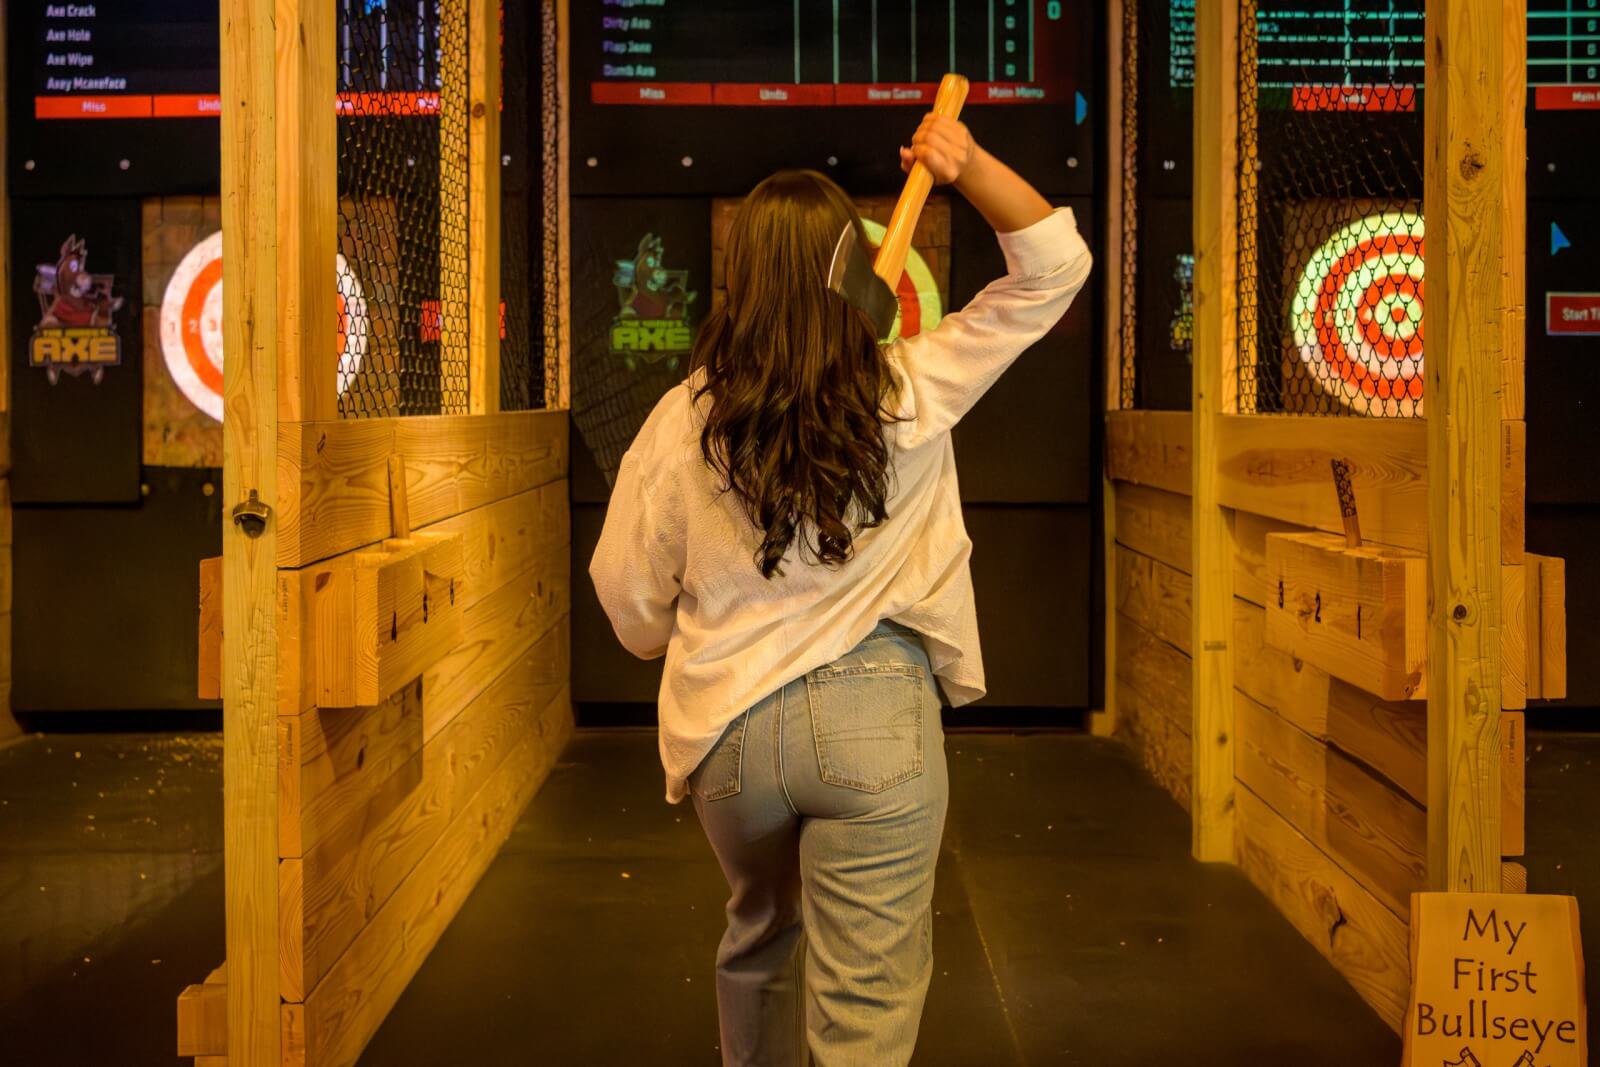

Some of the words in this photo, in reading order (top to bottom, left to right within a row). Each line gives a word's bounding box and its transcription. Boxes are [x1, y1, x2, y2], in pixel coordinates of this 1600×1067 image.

[46, 4, 65, 17] Axe
[67, 4, 96, 17] Crack
[46, 29, 65, 42] Axe
[67, 29, 91, 42] Hole
[46, 53, 66, 66] Axe
[67, 53, 93, 67] Wipe
[47, 78, 72, 92] Axey
[639, 88, 666, 99] Miss
[988, 87, 1013, 99] Main
[81, 101, 107, 112] Miss
[1562, 307, 1588, 320] Start
[613, 328, 690, 350] AXE
[34, 336, 117, 362] AXE
[1462, 908, 1527, 956] My
[1453, 957, 1538, 995] First
[1417, 998, 1577, 1055] Bullseye
